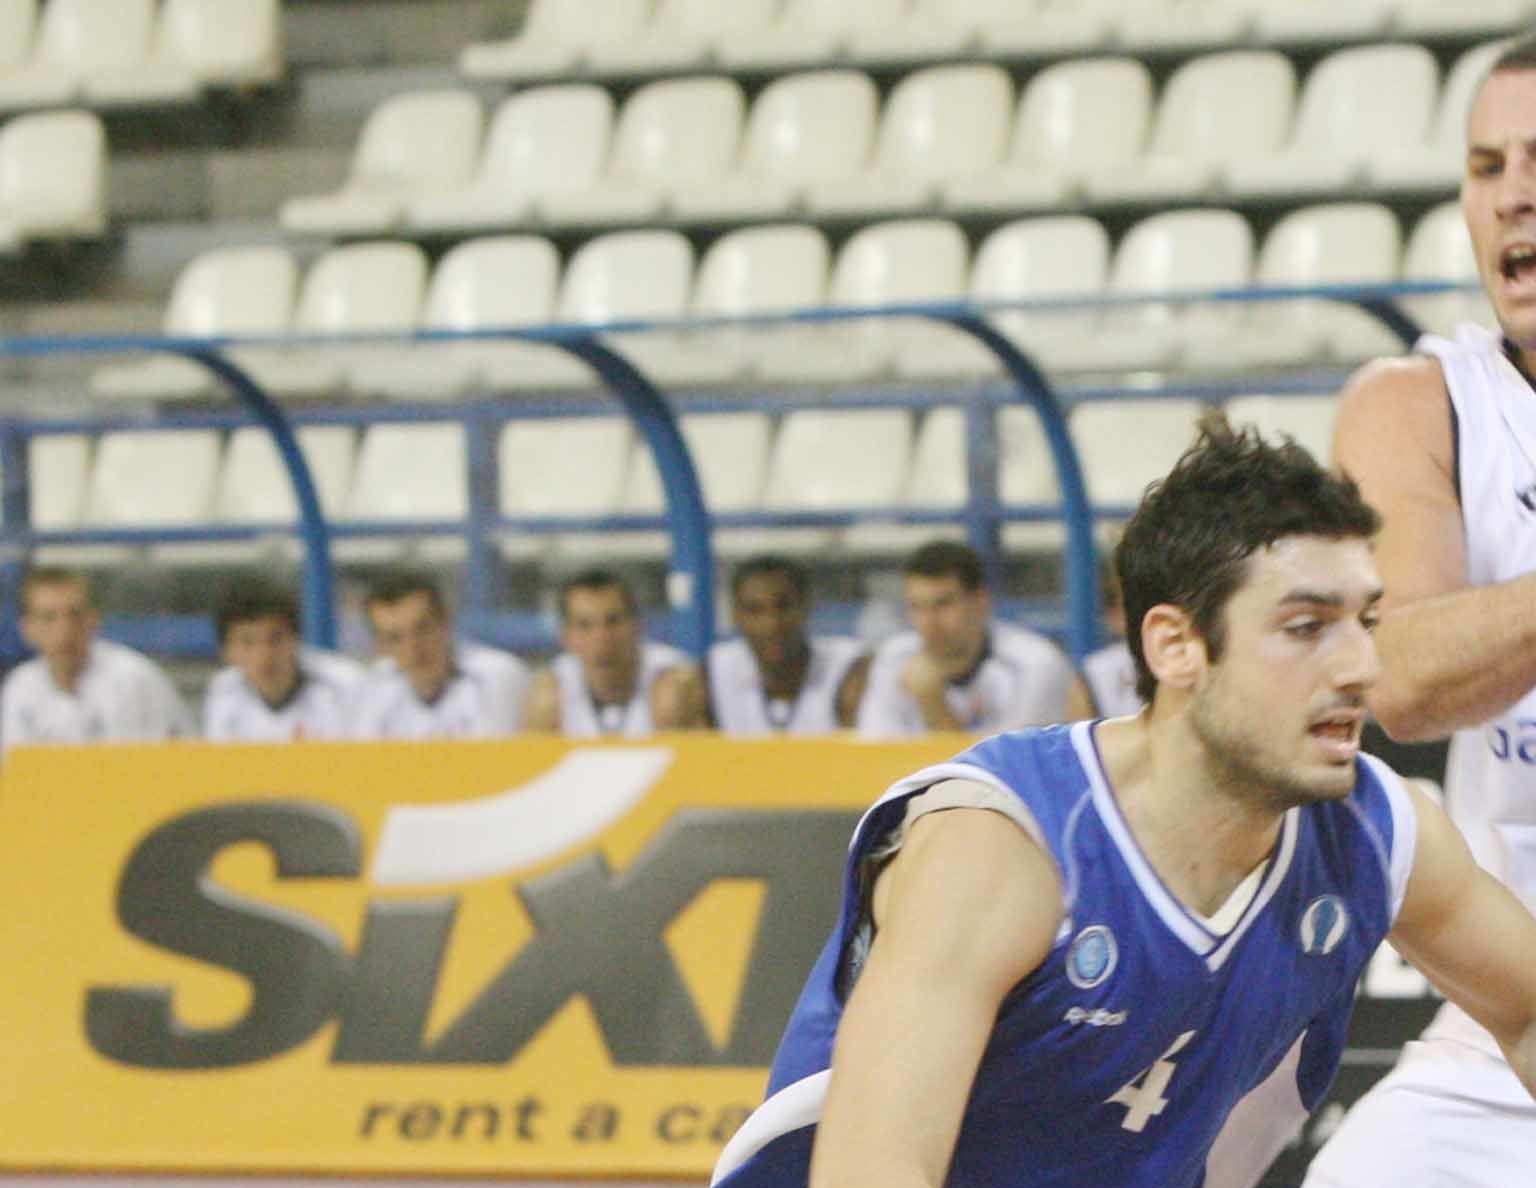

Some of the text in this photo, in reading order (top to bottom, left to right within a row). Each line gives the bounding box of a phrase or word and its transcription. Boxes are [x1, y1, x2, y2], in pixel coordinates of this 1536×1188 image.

[1102, 1029, 1197, 1133] 4
[359, 1096, 543, 1143] rent
[571, 1100, 622, 1143] a
